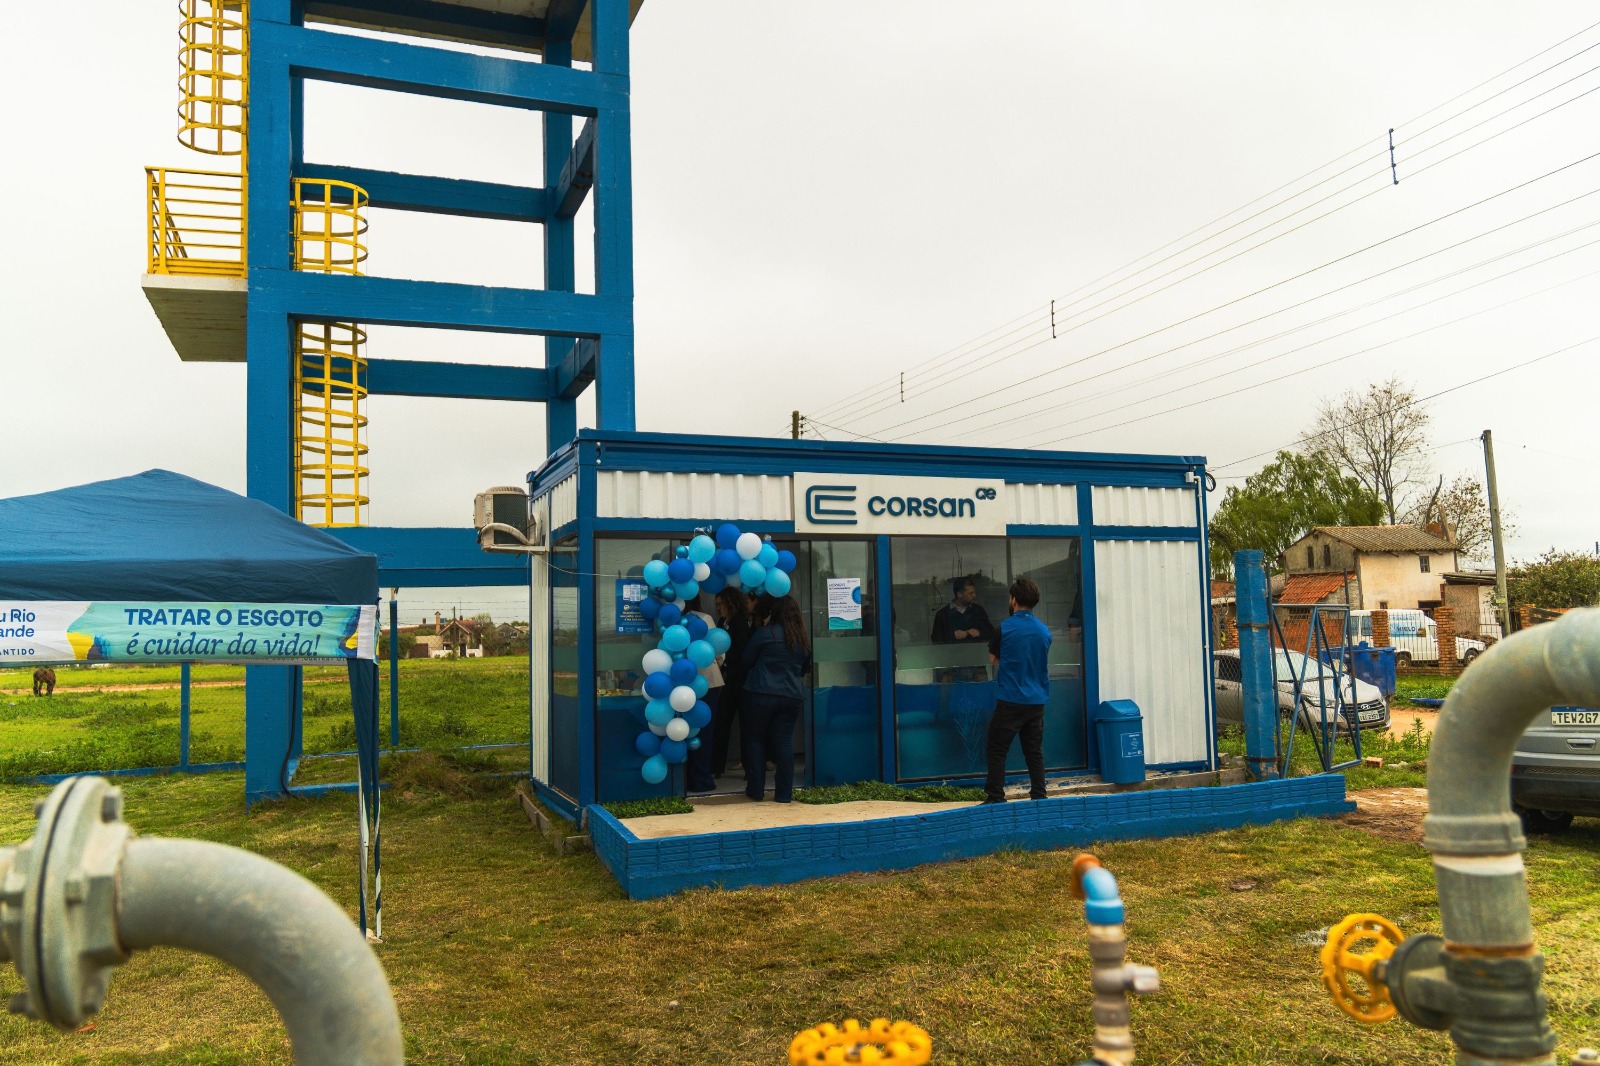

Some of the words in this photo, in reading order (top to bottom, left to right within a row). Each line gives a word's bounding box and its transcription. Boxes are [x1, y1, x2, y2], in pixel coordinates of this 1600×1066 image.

[10, 608, 36, 623] Rio
[124, 608, 211, 626] TRATAR
[215, 608, 233, 626] O
[237, 609, 324, 628] ESGOTO
[0, 648, 36, 656] NTIDO
[126, 632, 140, 656] é
[143, 631, 224, 656] cuidar
[227, 631, 257, 656] da
[263, 632, 321, 657] vida!
